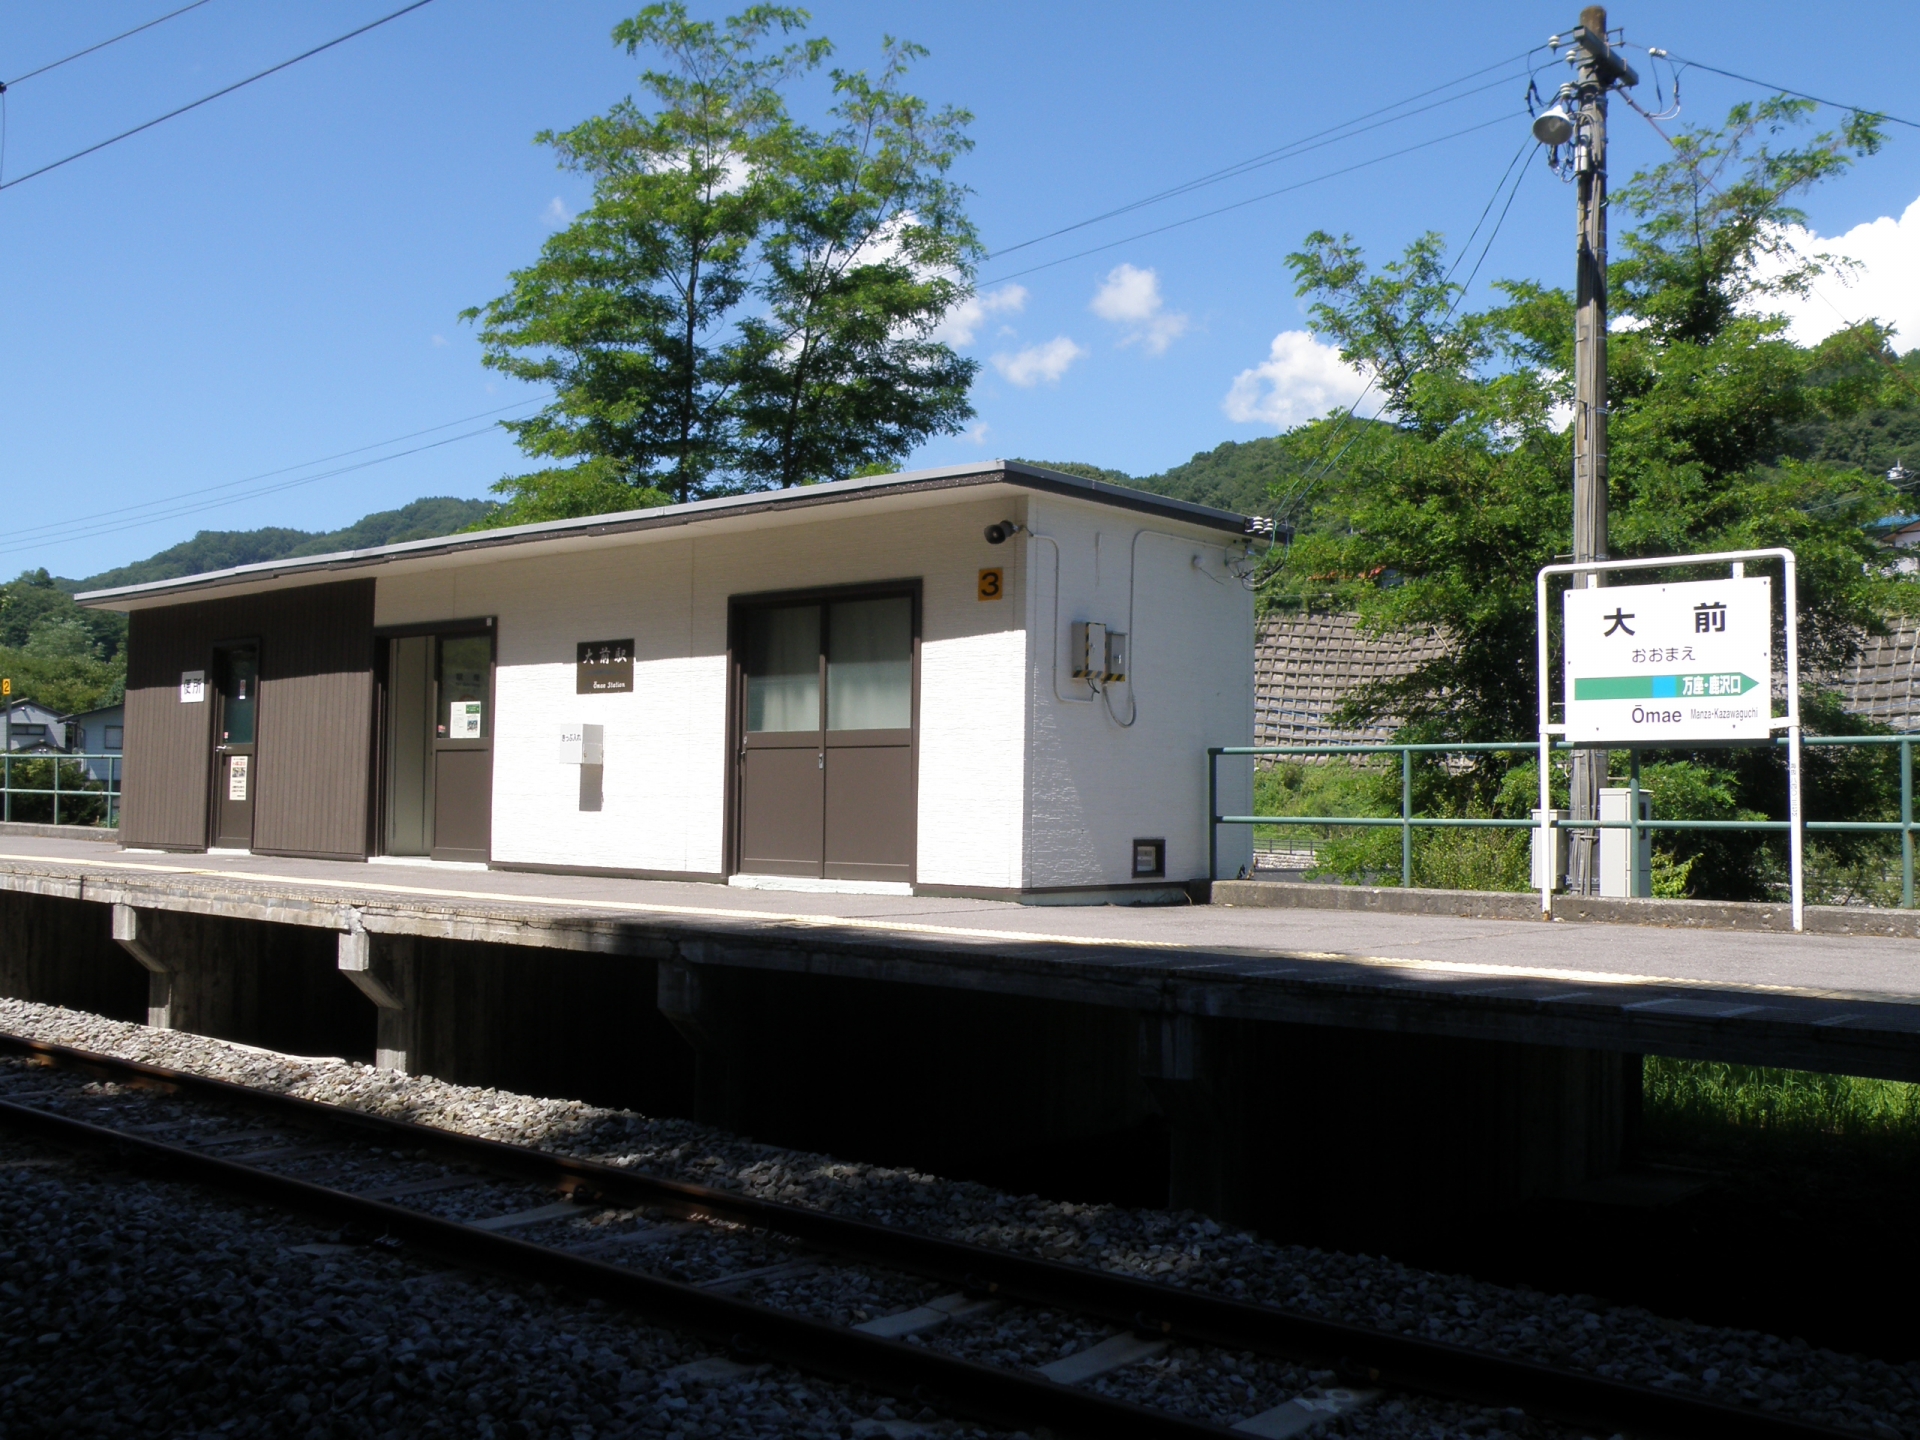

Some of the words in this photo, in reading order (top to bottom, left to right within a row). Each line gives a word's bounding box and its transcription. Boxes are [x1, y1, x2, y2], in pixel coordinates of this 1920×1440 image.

[981, 571, 999, 597] 3
[583, 647, 627, 664] 大前駅
[1631, 646, 1696, 663] おおまえ
[4, 680, 9, 692] 2
[183, 678, 202, 695] 便所
[607, 681, 625, 689] Station
[1631, 704, 1682, 724] Ōmae
